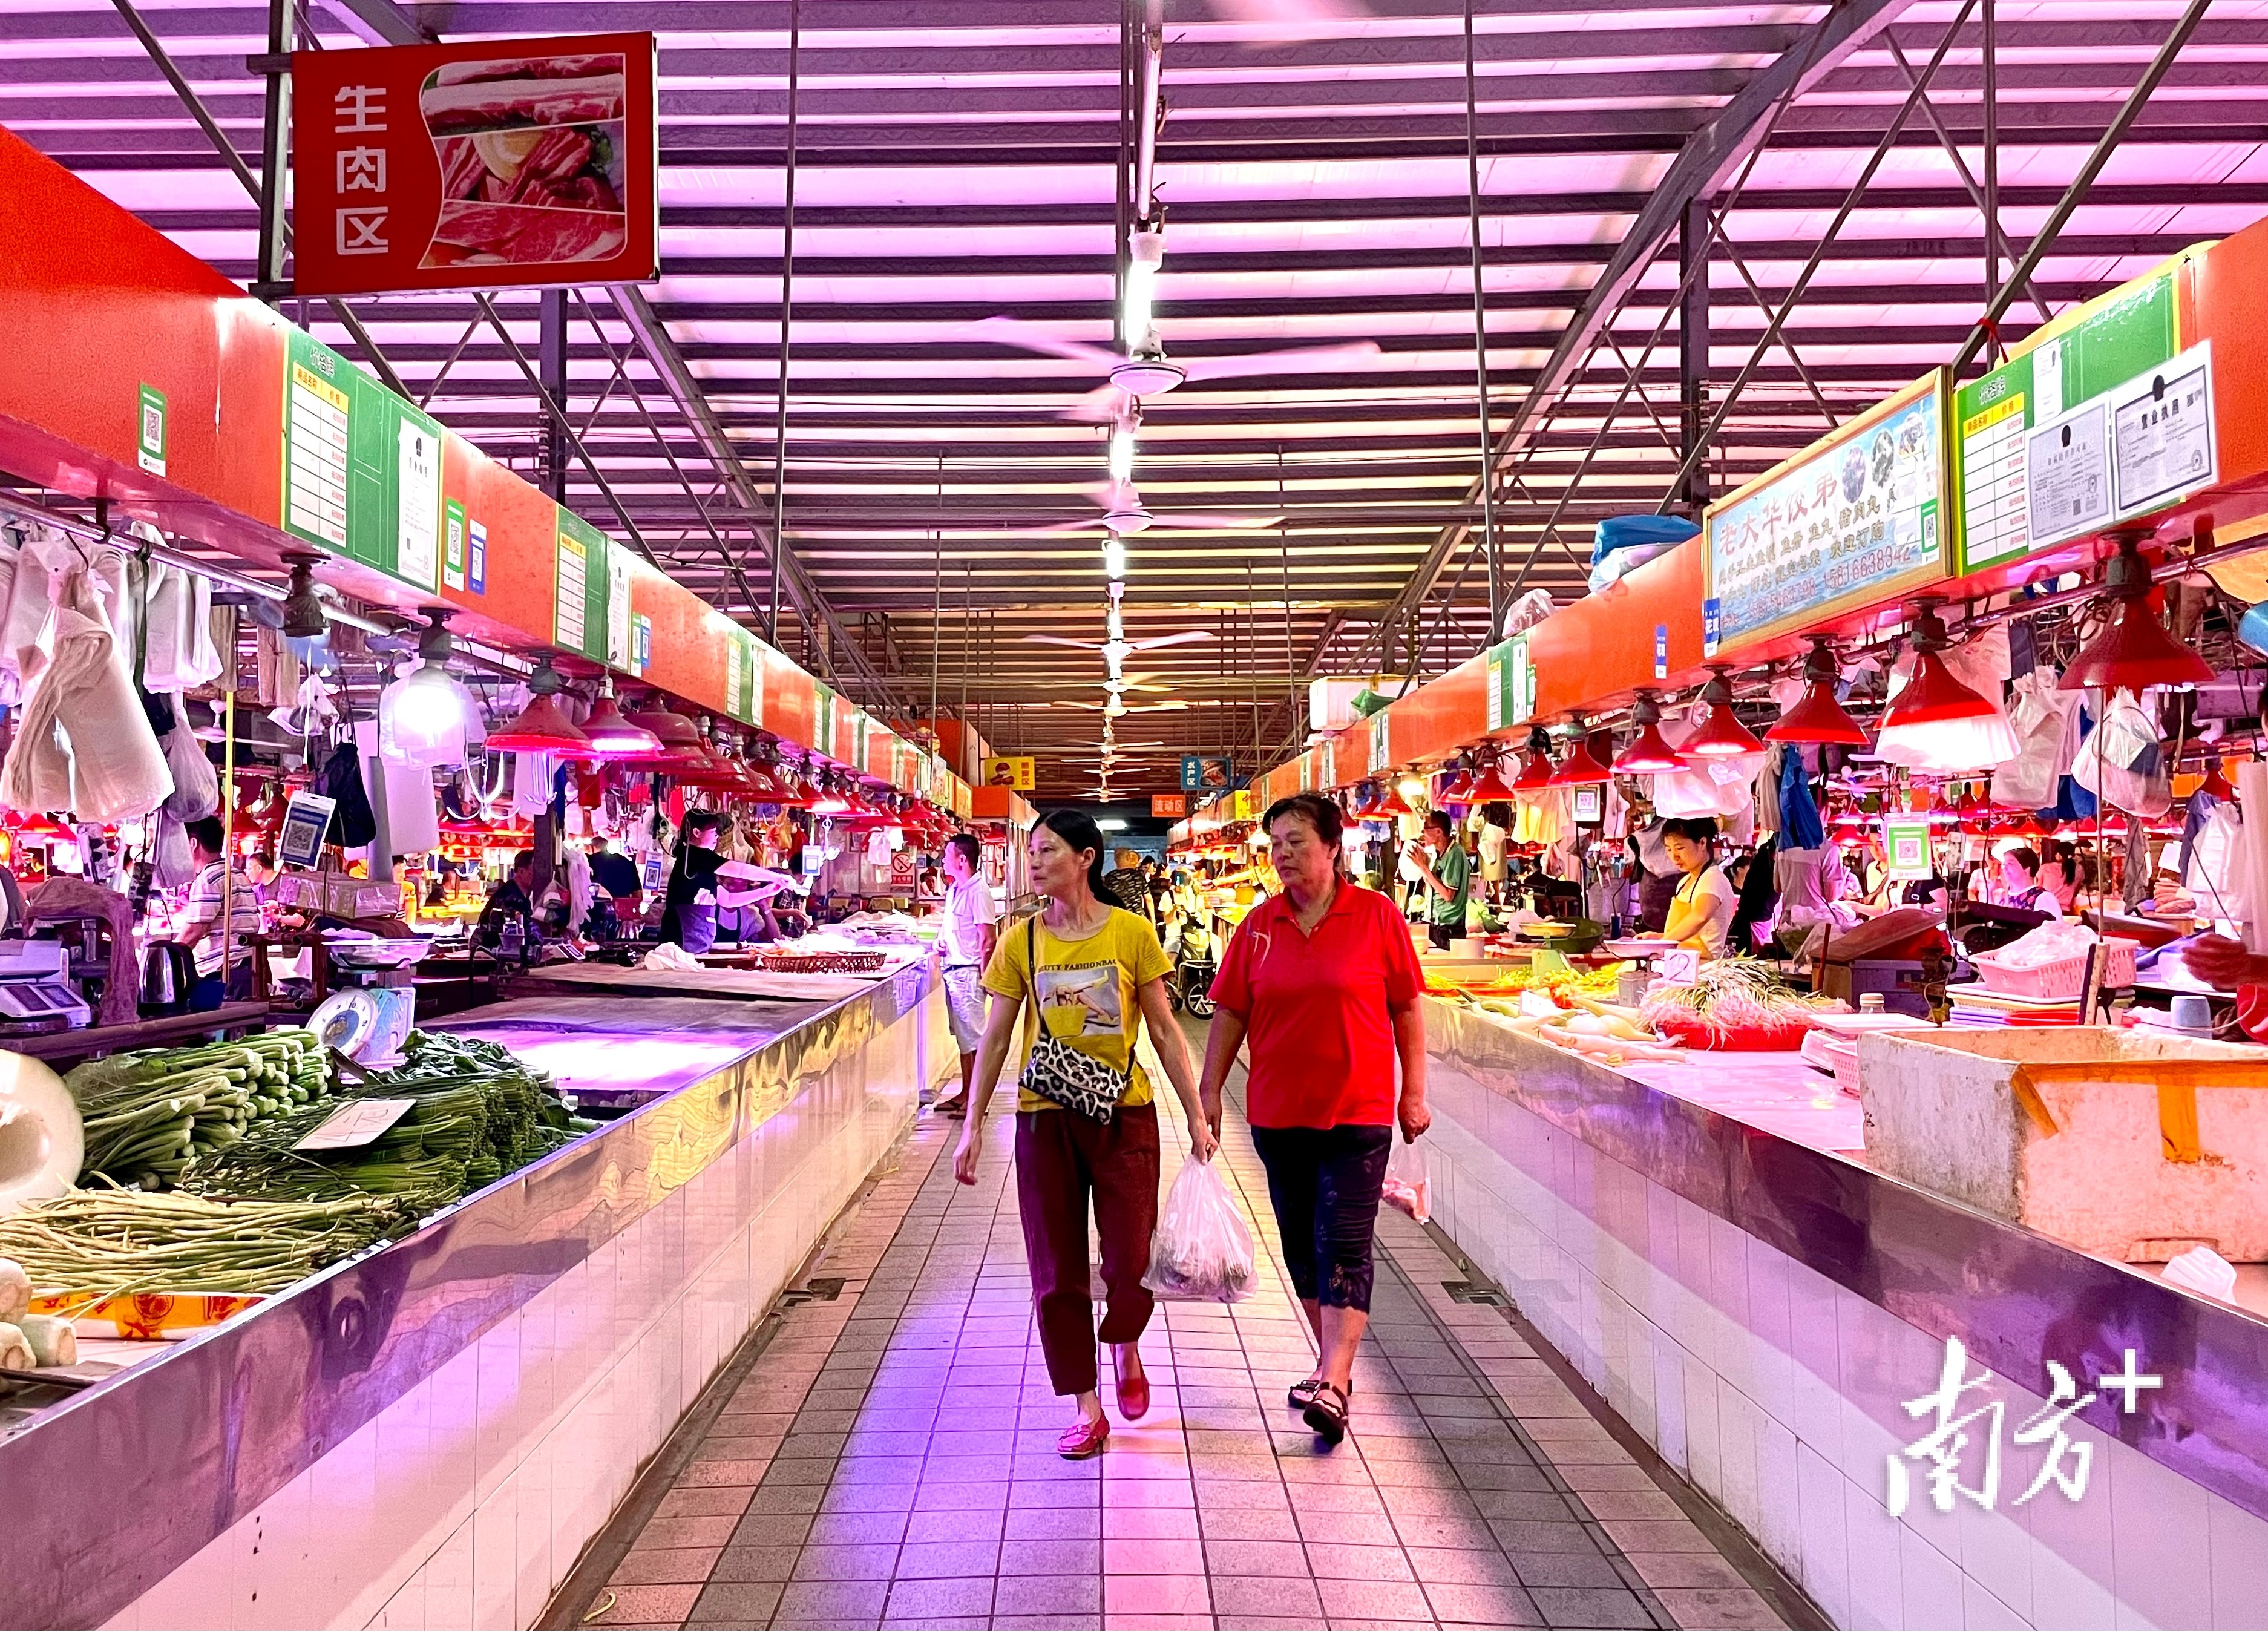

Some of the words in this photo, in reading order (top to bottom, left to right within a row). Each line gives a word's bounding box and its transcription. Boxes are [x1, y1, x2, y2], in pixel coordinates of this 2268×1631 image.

[335, 85, 388, 255] 生肉区
[2141, 398, 2180, 430] 营业执照
[1829, 519, 1884, 560] 欢迎订购
[1153, 799, 1184, 813] 流动区
[1669, 953, 1693, 983] 2
